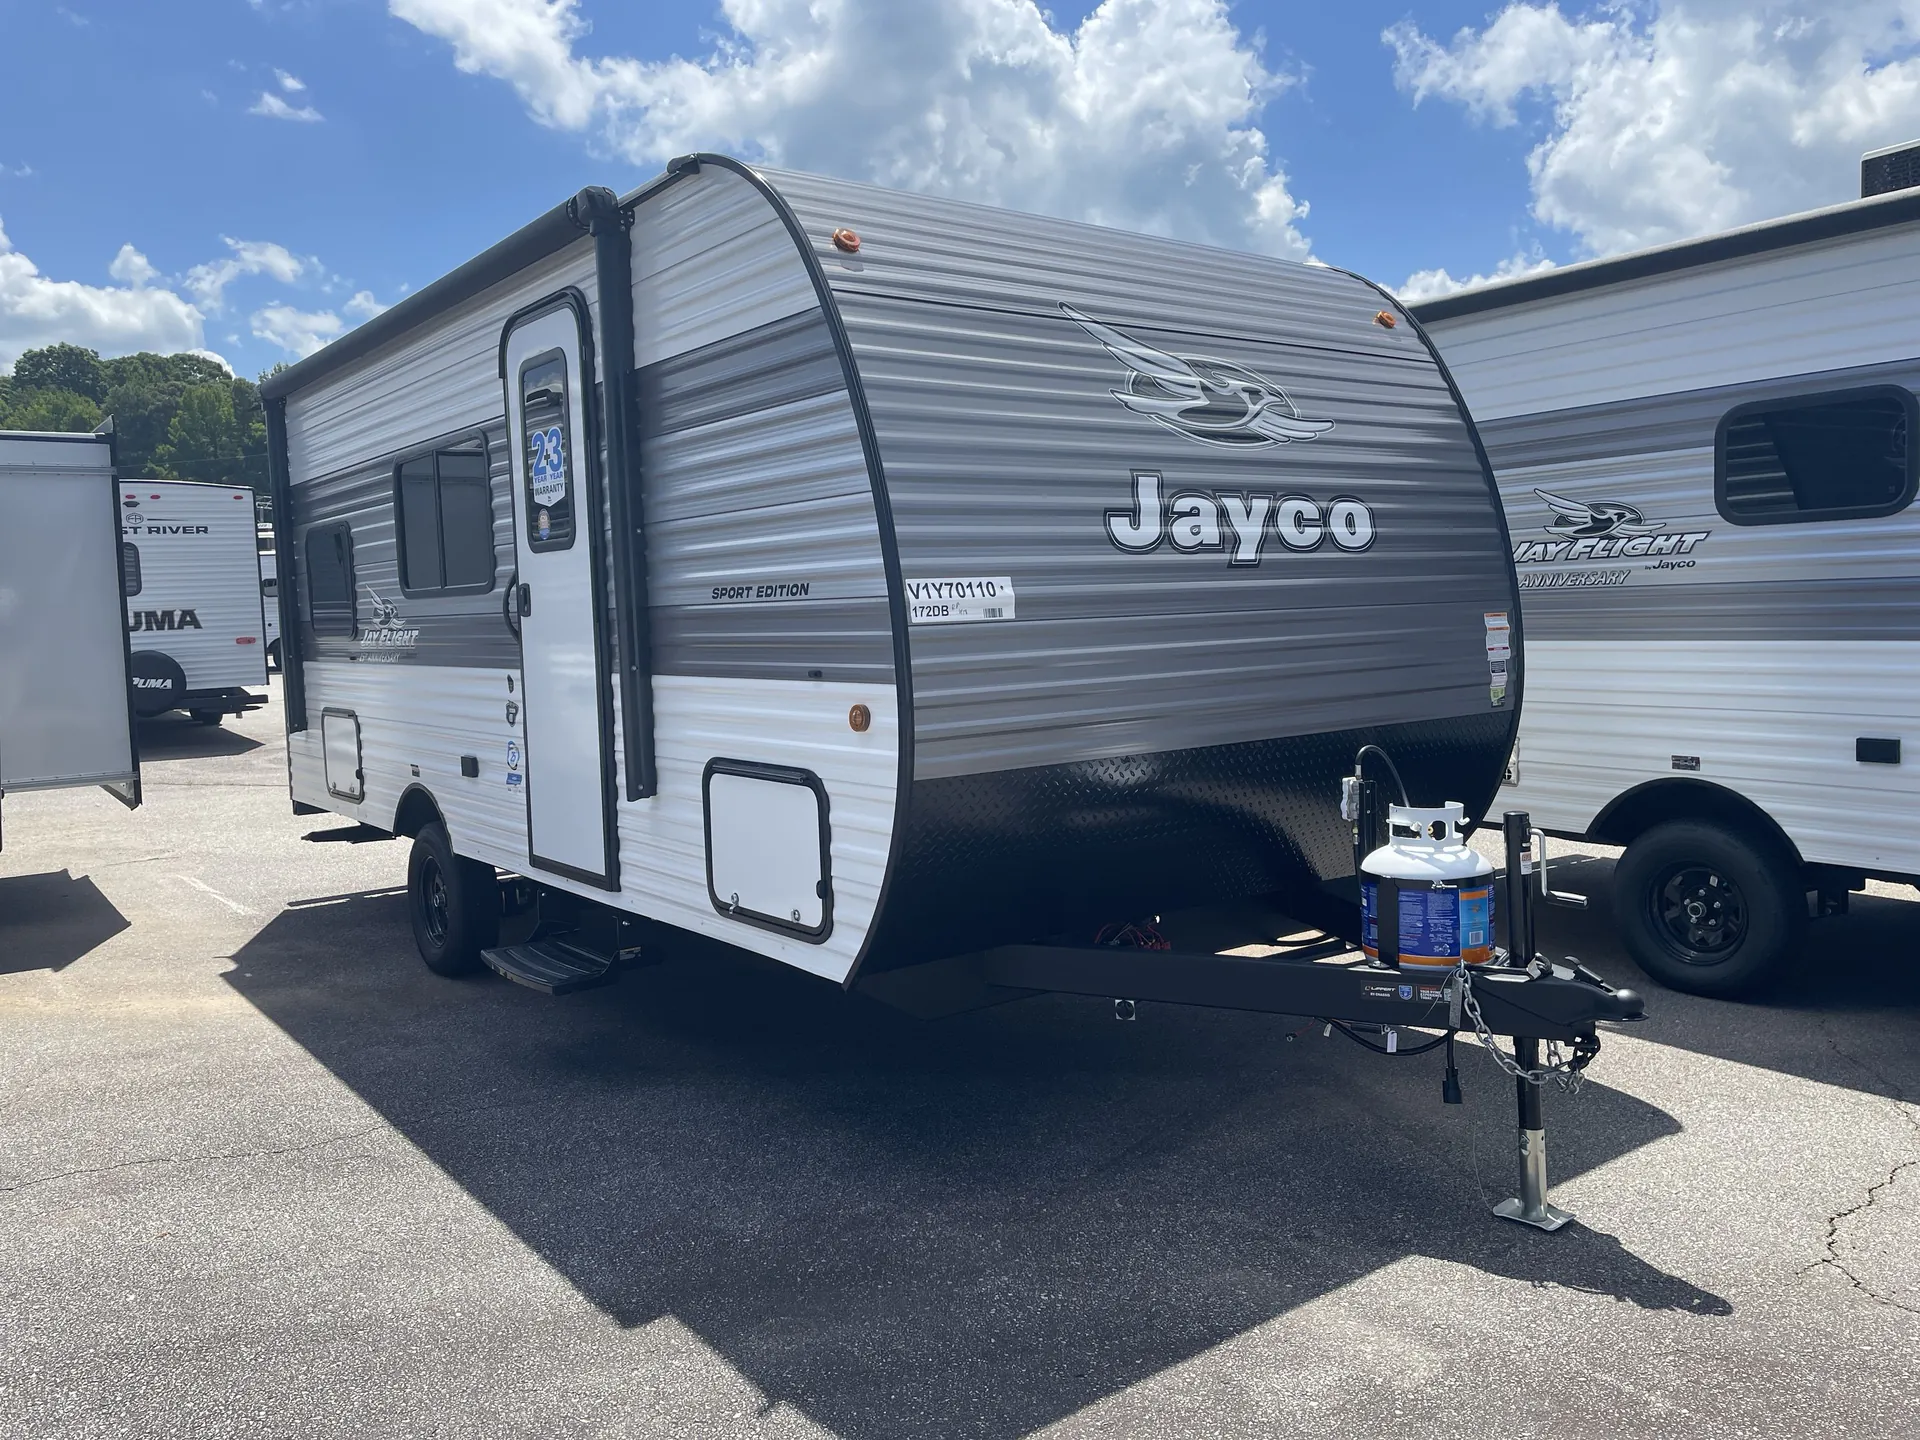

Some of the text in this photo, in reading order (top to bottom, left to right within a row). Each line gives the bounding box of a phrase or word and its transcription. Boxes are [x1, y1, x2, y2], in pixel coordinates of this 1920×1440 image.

[534, 472, 563, 483] YEAR YEAR
[534, 483, 564, 497] WARRANTY
[1105, 468, 1377, 568] Jayco
[147, 525, 209, 535] RIVER
[1566, 530, 1712, 560] FLIGHT
[1652, 559, 1696, 570] Jayco
[1519, 569, 1631, 588] ANNIVERSARY
[711, 582, 810, 600] SPORT EDITION
[907, 580, 997, 600] V1Y70110
[912, 605, 950, 618] 172DB
[360, 628, 419, 647] JAY FLIGHT
[133, 677, 172, 690] PUMA
